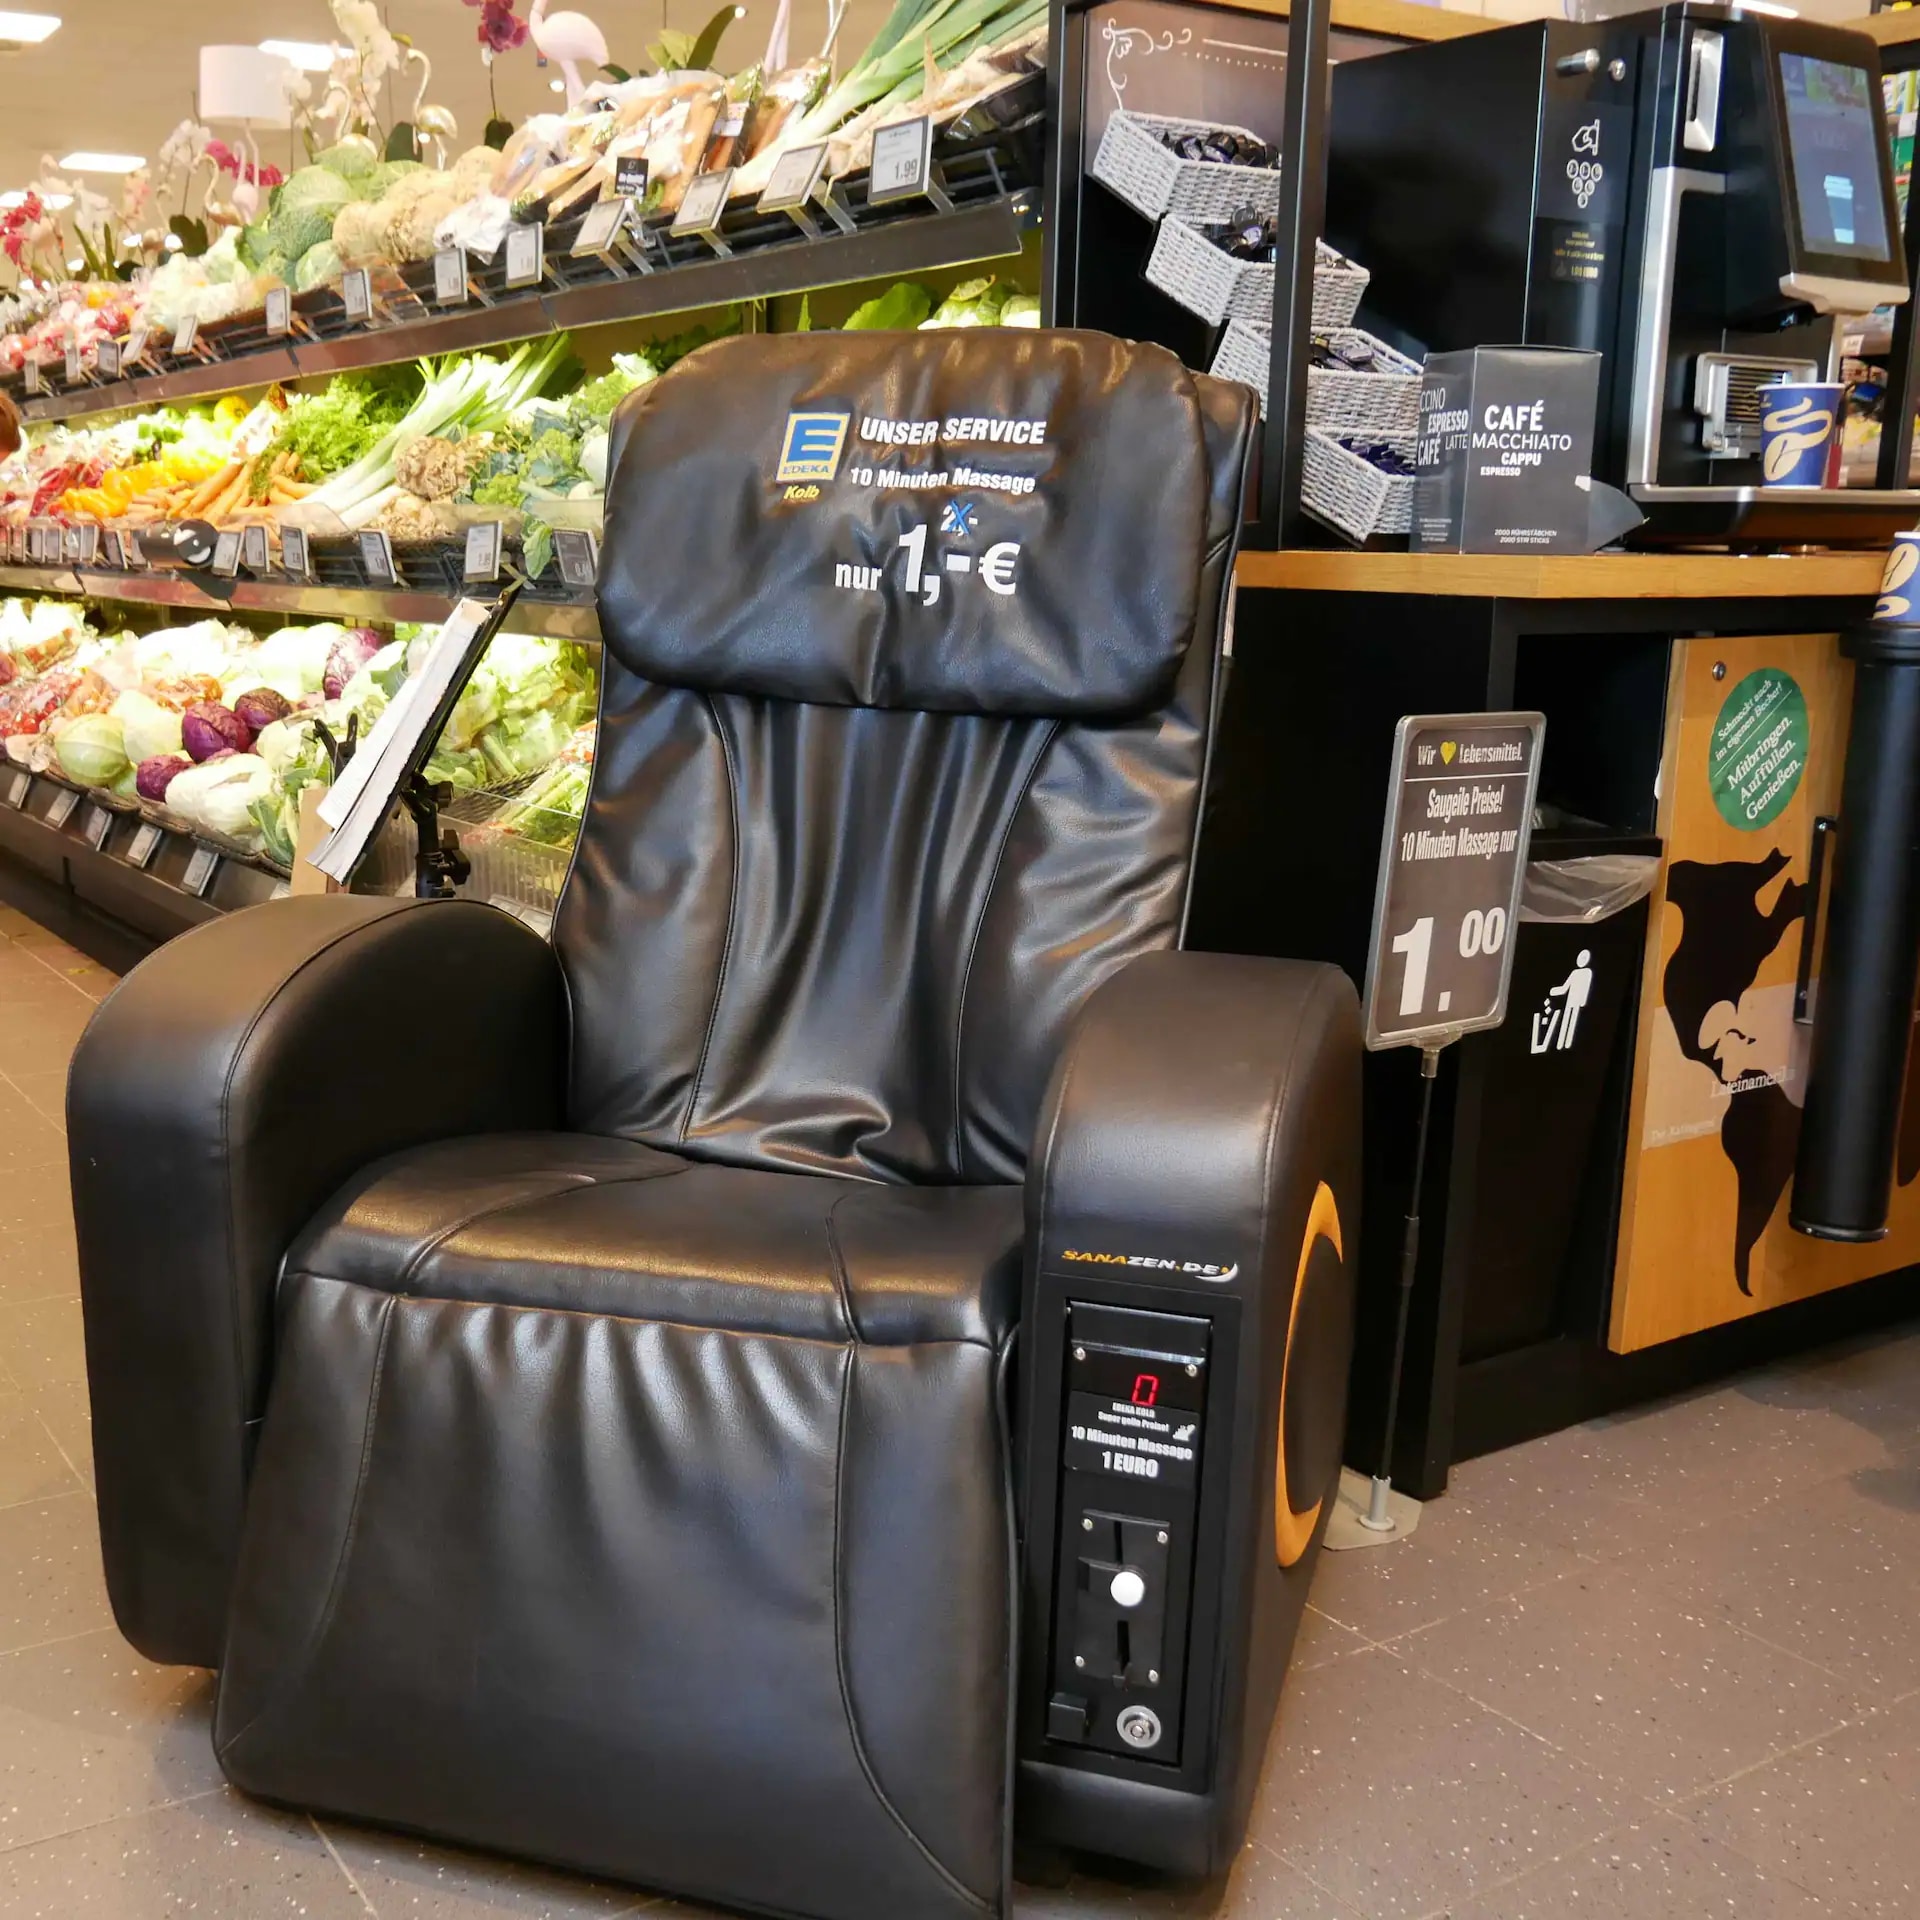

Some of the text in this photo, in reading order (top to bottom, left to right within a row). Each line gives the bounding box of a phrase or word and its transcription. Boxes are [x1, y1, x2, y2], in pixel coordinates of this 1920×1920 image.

[1427, 409, 1469, 434] ESPRESSO
[1484, 400, 1545, 432] CAFÉ
[861, 417, 1047, 445] UNSER SERVICE
[1472, 433, 1572, 451] MACCHIATO
[1418, 431, 1469, 466] CAFÉ LATTE
[1501, 452, 1542, 466] CAPPU
[782, 464, 830, 475] EDEKA
[851, 467, 1036, 496] 10 Minuten Massage
[1480, 466, 1521, 476] ESPRESSO
[783, 485, 821, 501] Kolb
[835, 563, 882, 591] nur
[1718, 680, 1772, 741] Schmeckt auch
[1715, 747, 1727, 762] im
[1727, 715, 1755, 749] eigenen
[1417, 742, 1523, 765] Wir Lebensmittel.
[1727, 717, 1793, 790] Mitbringen.
[1740, 739, 1797, 805] Auffüllen.
[1427, 784, 1505, 824] Saugeile Preise!
[1746, 759, 1801, 820] Genießen.
[1401, 827, 1518, 862] 10 Minuten Massage nur
[1062, 1249, 1221, 1276] SANAZEN.DE
[1132, 1374, 1159, 1407] 0
[1071, 1425, 1193, 1460] 10 Minuten Massage
[1102, 1451, 1159, 1478] 1 EURO
